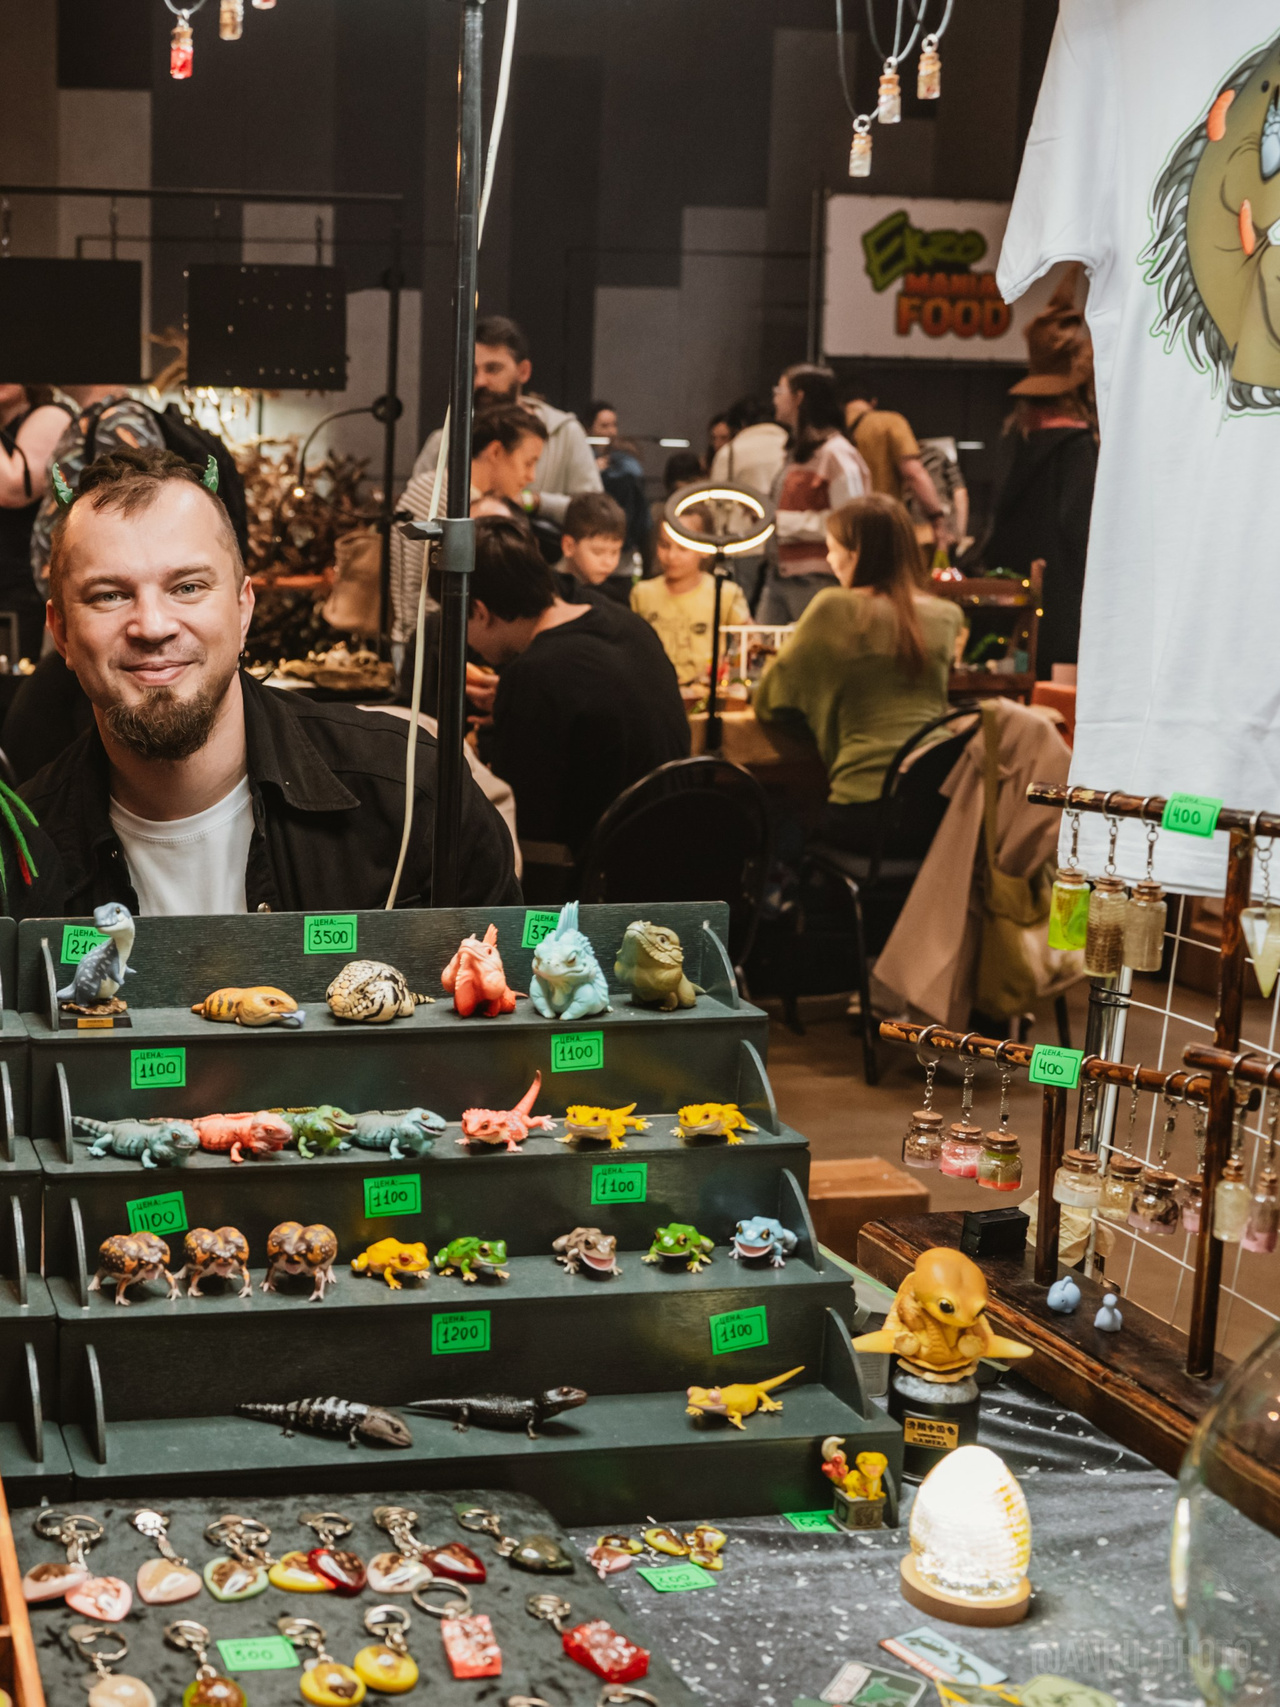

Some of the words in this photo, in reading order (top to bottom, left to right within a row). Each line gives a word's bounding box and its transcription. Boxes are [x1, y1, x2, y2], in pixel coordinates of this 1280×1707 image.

[896, 295, 1012, 338] FOOD
[1173, 806, 1201, 825] 400
[73, 929, 97, 937] ЦЕНА:
[313, 930, 348, 945] 3500
[140, 1051, 164, 1060] ЦЕНА:
[560, 1045, 593, 1061] 1100
[1041, 1048, 1064, 1058] ЦЕНА:
[139, 1061, 176, 1078] 1100
[1039, 1058, 1064, 1075] 400
[600, 1178, 635, 1195] 1100
[373, 1189, 408, 1208] 1100
[139, 1210, 175, 1230] 1100
[442, 1325, 479, 1344] 1200
[720, 1323, 753, 1343] 1100
